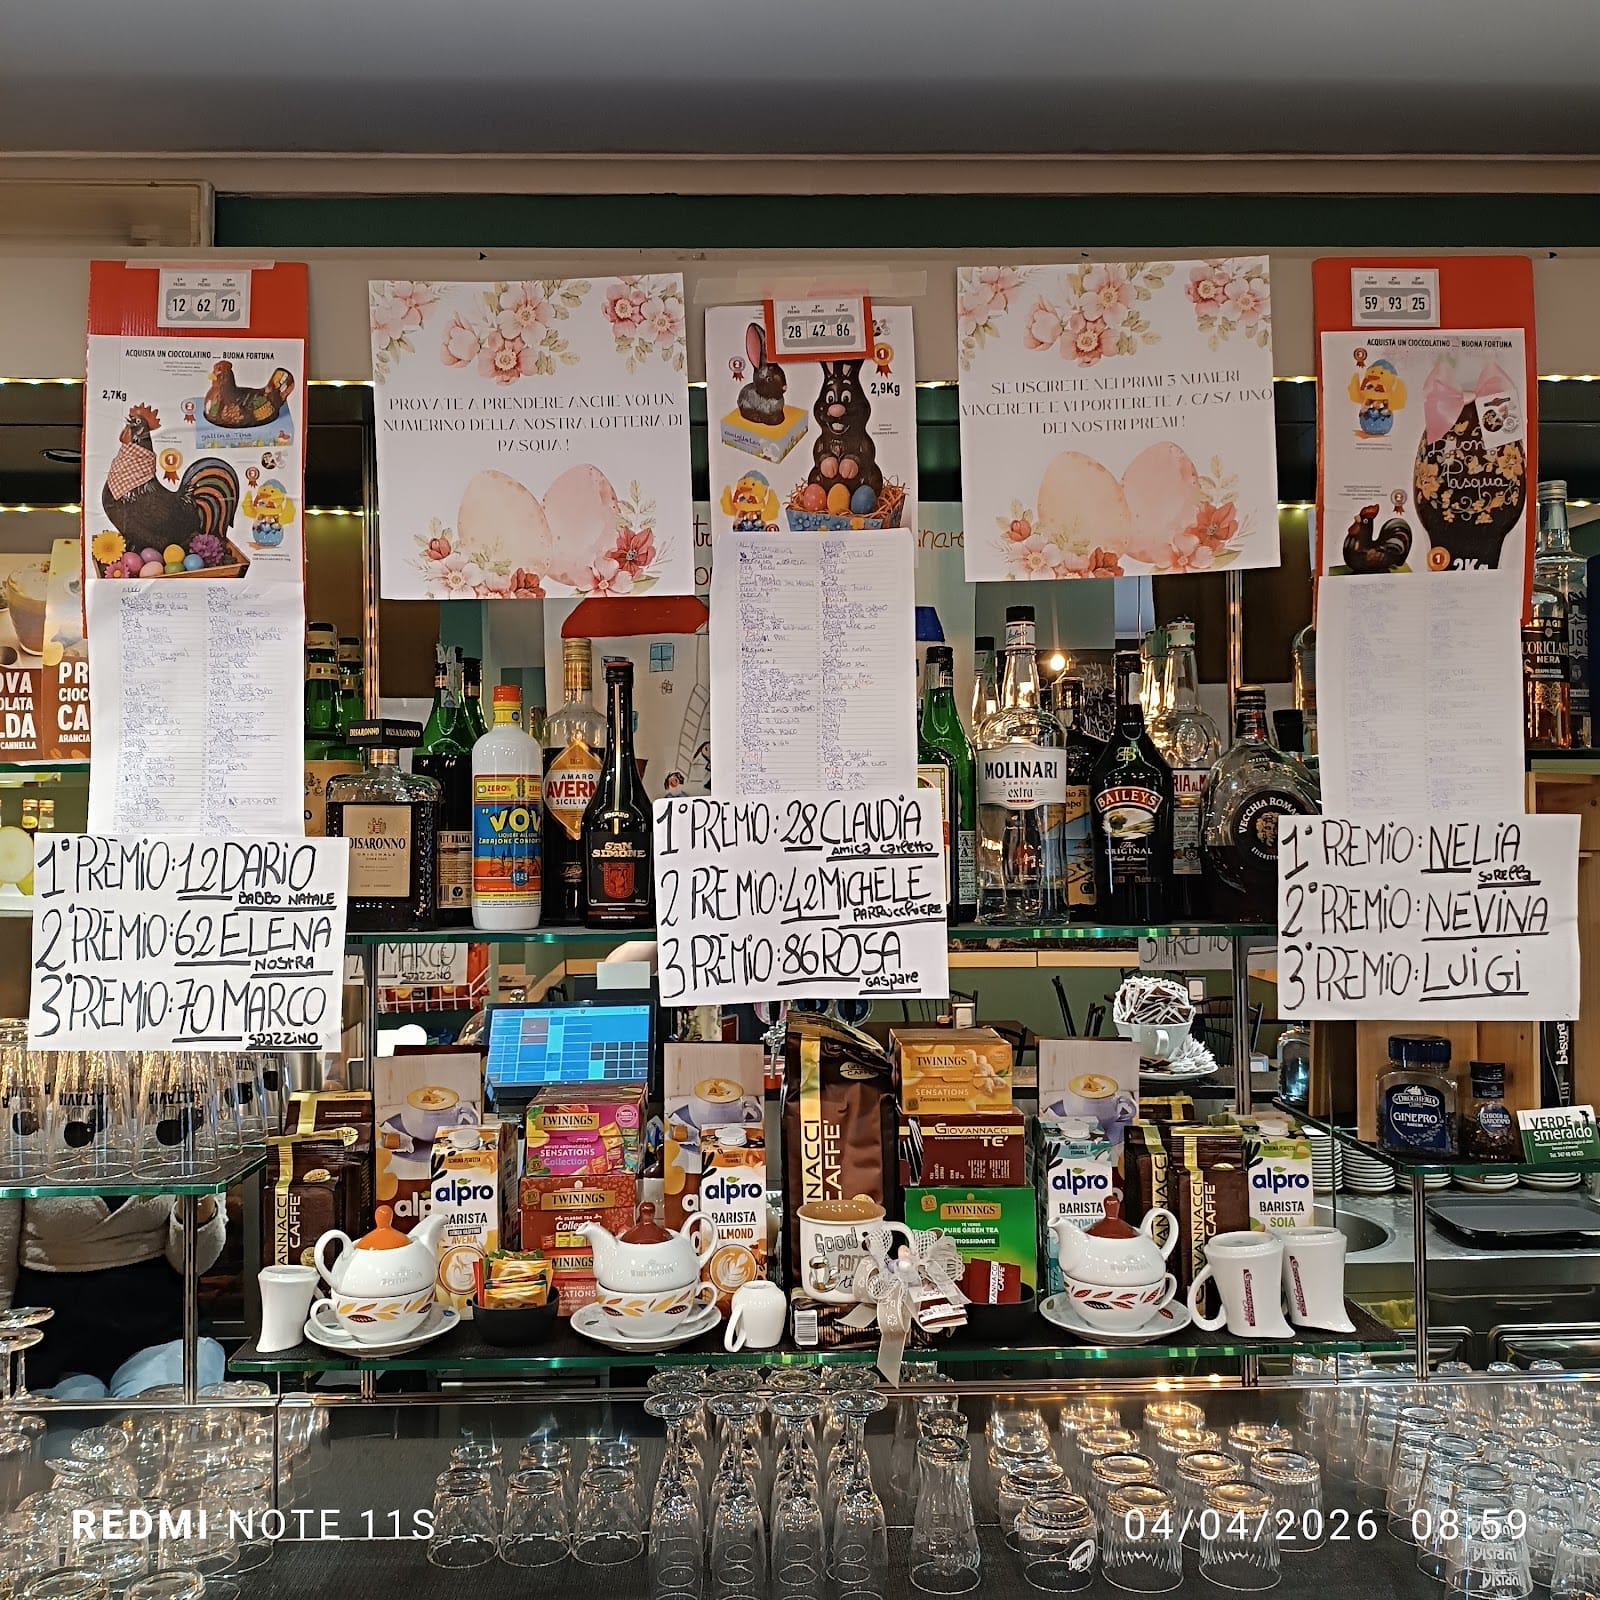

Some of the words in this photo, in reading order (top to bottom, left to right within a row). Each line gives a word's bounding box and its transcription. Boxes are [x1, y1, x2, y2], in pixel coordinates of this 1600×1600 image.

[173, 298, 186, 312] 12
[197, 298, 211, 312] 62
[221, 298, 235, 312] 70
[1365, 297, 1378, 310] 59
[1388, 297, 1402, 310] 93
[1412, 297, 1425, 310] 25
[788, 325, 801, 338] 28
[812, 324, 826, 337] 42
[836, 323, 850, 337] 86
[1367, 338, 1396, 346] ACQUISTA
[1408, 339, 1450, 347] CIOCCOLATINO
[1461, 340, 1482, 348] BUONA
[1484, 340, 1512, 348] FORTUNA
[125, 349, 155, 358] ACQUISTA
[157, 350, 166, 358] UN
[167, 350, 211, 359] CIOCCOLATINO
[222, 351, 245, 360] BUONA
[245, 352, 275, 360] FORTUNA
[870, 382, 900, 396] 2,9Kg
[991, 381, 1011, 394] SE
[1015, 378, 1089, 393] USCIRETE
[1094, 377, 1118, 390] NEI
[1122, 375, 1163, 389] PRIMI
[1181, 370, 1240, 385] NUMERI
[102, 390, 127, 401] 2,7Kg
[390, 398, 463, 410] PROVATE
[468, 398, 480, 410] A
[483, 396, 563, 410] PRENDERE
[568, 395, 620, 408] ANCHE
[625, 393, 650, 406] VOI
[654, 392, 675, 406] UN
[961, 401, 1045, 416] VINCERETE
[1050, 400, 1060, 413] E
[1063, 399, 1078, 412] VI
[1081, 395, 1171, 411] PORTERETE
[1176, 395, 1188, 407] A
[1191, 391, 1237, 405] CASA
[1240, 388, 1273, 401] UNO
[384, 419, 465, 431] NUMERINO
[470, 418, 520, 431] DELLA
[524, 417, 587, 430] NOSTRA
[591, 414, 664, 429] LOTTERIA
[668, 413, 682, 426] DI
[1043, 422, 1066, 435] DEI
[1071, 418, 1126, 433] NOSTRI
[1453, 558, 1488, 570] 2K
[1536, 656, 1560, 664] NERA
[349, 727, 379, 737] DISARONNO
[385, 728, 421, 738] DISARONNO
[985, 761, 1058, 780] MOLINARI
[546, 781, 599, 799] AVERN
[1008, 787, 1034, 798] extra
[1098, 791, 1157, 808] BAILEYS
[780, 800, 818, 844] 28
[1239, 798, 1269, 834] VECCHIA
[604, 842, 633, 850] SAN
[591, 850, 646, 858] SIMONE
[176, 842, 219, 893] 12
[660, 869, 680, 926] 2
[783, 866, 818, 917] 42
[174, 910, 217, 959] 62
[220, 912, 332, 958] ELENA
[662, 937, 686, 999] 3
[782, 933, 819, 975] 86
[821, 927, 902, 976] ROSA
[175, 978, 214, 1035] 70
[222, 978, 327, 1032] MARCO
[917, 1056, 967, 1066] TWININGS
[915, 1088, 969, 1096] SENSATIONS
[541, 1115, 593, 1126] TWININGS
[1393, 1112, 1438, 1124] GINEPRO
[1530, 1115, 1571, 1129] VERDE
[934, 1122, 1010, 1135] GIOVANNACCI
[1533, 1124, 1592, 1142] smeraldo
[540, 1148, 595, 1157] SENSATIONS
[544, 1158, 588, 1166] Collection
[1052, 1168, 1109, 1195] alpro
[1252, 1167, 1310, 1194] alpro
[435, 1180, 494, 1206] alpro
[705, 1177, 762, 1204] alpro
[552, 1192, 605, 1205] TWININGS
[394, 1191, 431, 1221] alp
[946, 1205, 995, 1215] TWININGS
[1059, 1202, 1103, 1213] BARISTA
[1260, 1201, 1304, 1212] BARISTA
[445, 1213, 488, 1225] ARISTA
[1270, 1217, 1296, 1227] SOIA
